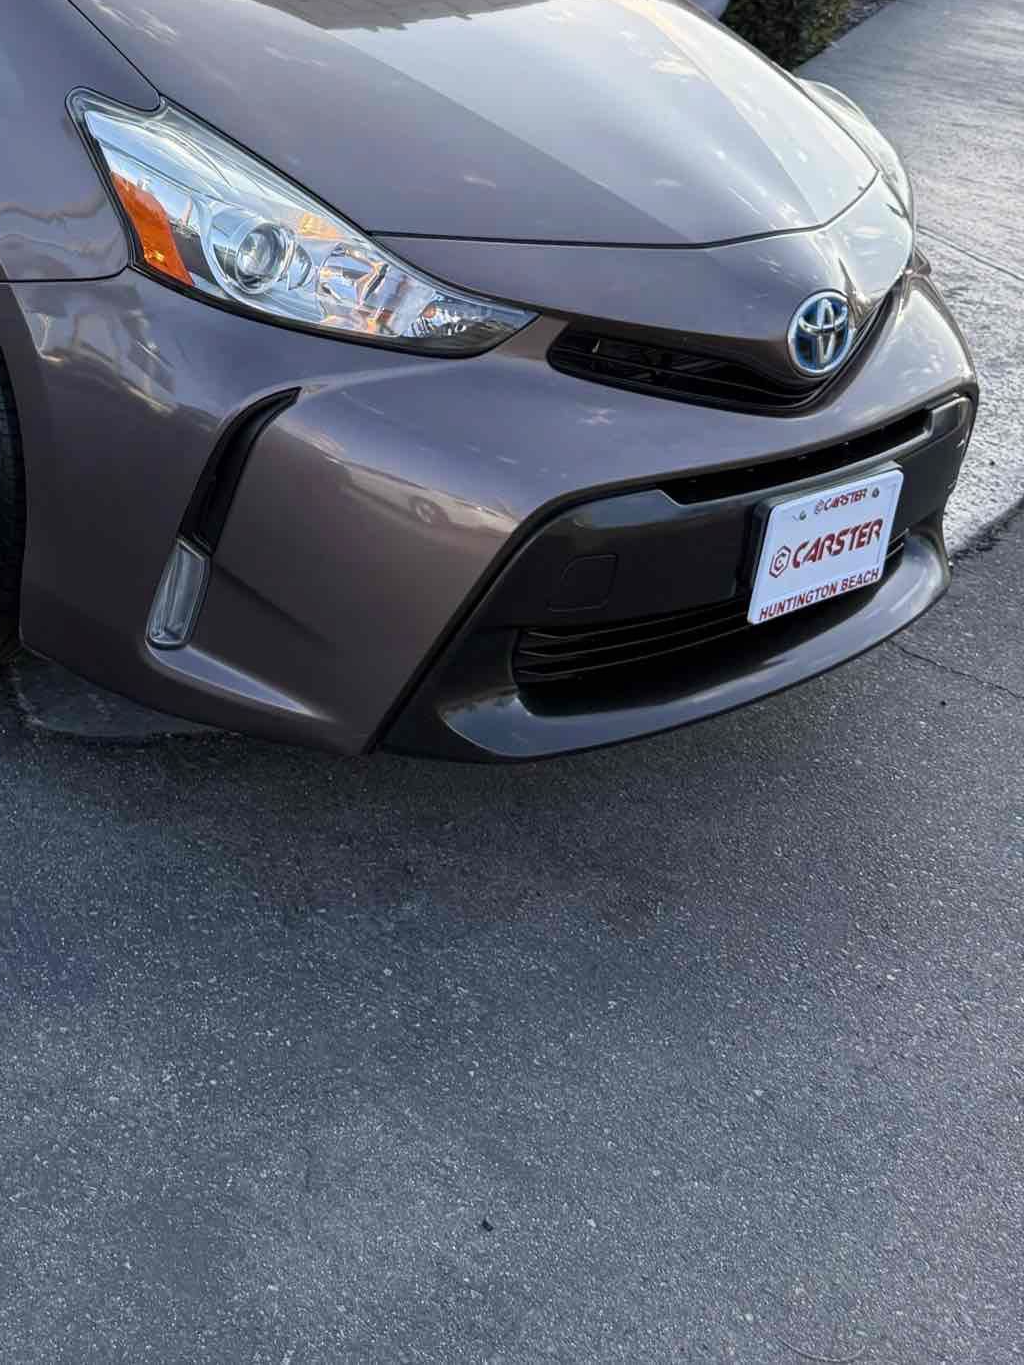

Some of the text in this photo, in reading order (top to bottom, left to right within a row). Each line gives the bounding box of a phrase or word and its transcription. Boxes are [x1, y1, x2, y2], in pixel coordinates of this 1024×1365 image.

[823, 488, 868, 512] CARSTER
[792, 518, 883, 569] CARSTER
[759, 567, 880, 621] HUNTINGTON BEACH
